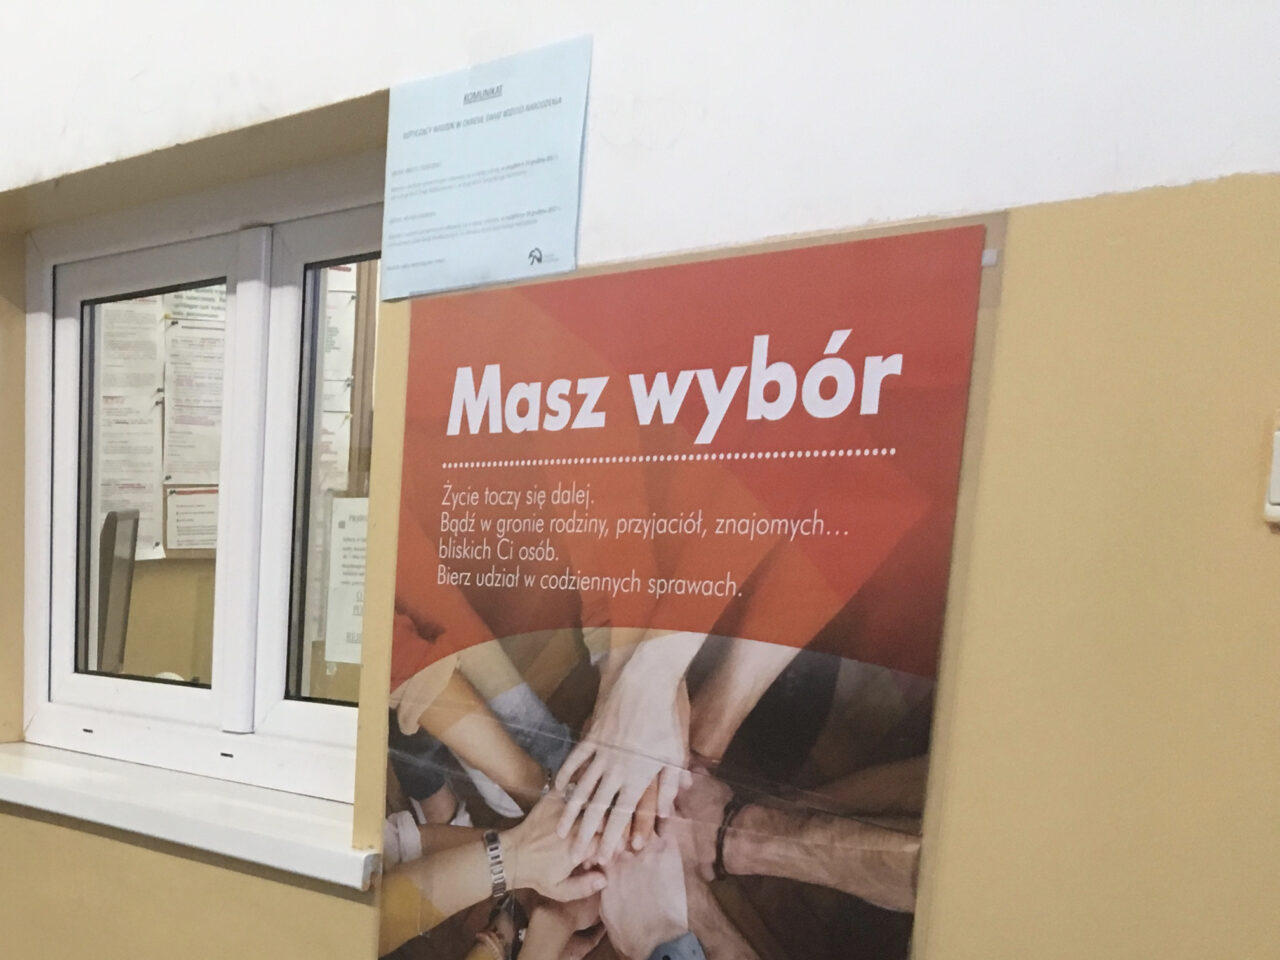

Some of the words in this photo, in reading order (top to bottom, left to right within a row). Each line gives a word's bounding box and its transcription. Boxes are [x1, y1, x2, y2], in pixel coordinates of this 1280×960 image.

[446, 364, 609, 436] Masz
[629, 329, 903, 444] wybór
[441, 480, 479, 511] Życie
[484, 487, 521, 511] toczy
[525, 484, 546, 509] się
[551, 481, 595, 510] dalej.
[440, 511, 476, 537] Bądź
[480, 519, 492, 531] w
[496, 513, 545, 537] gronie
[549, 510, 609, 540] rodziny,
[616, 508, 708, 540] przyjaciół,
[715, 508, 849, 542] znajomych...
[438, 537, 491, 560] bliskich
[497, 538, 514, 560] Ci
[518, 538, 559, 561] osób.
[437, 564, 472, 586] Bierz
[476, 564, 520, 588] udział
[524, 574, 536, 588] w
[539, 567, 641, 598] codziennych
[647, 571, 743, 599] sprawach.
